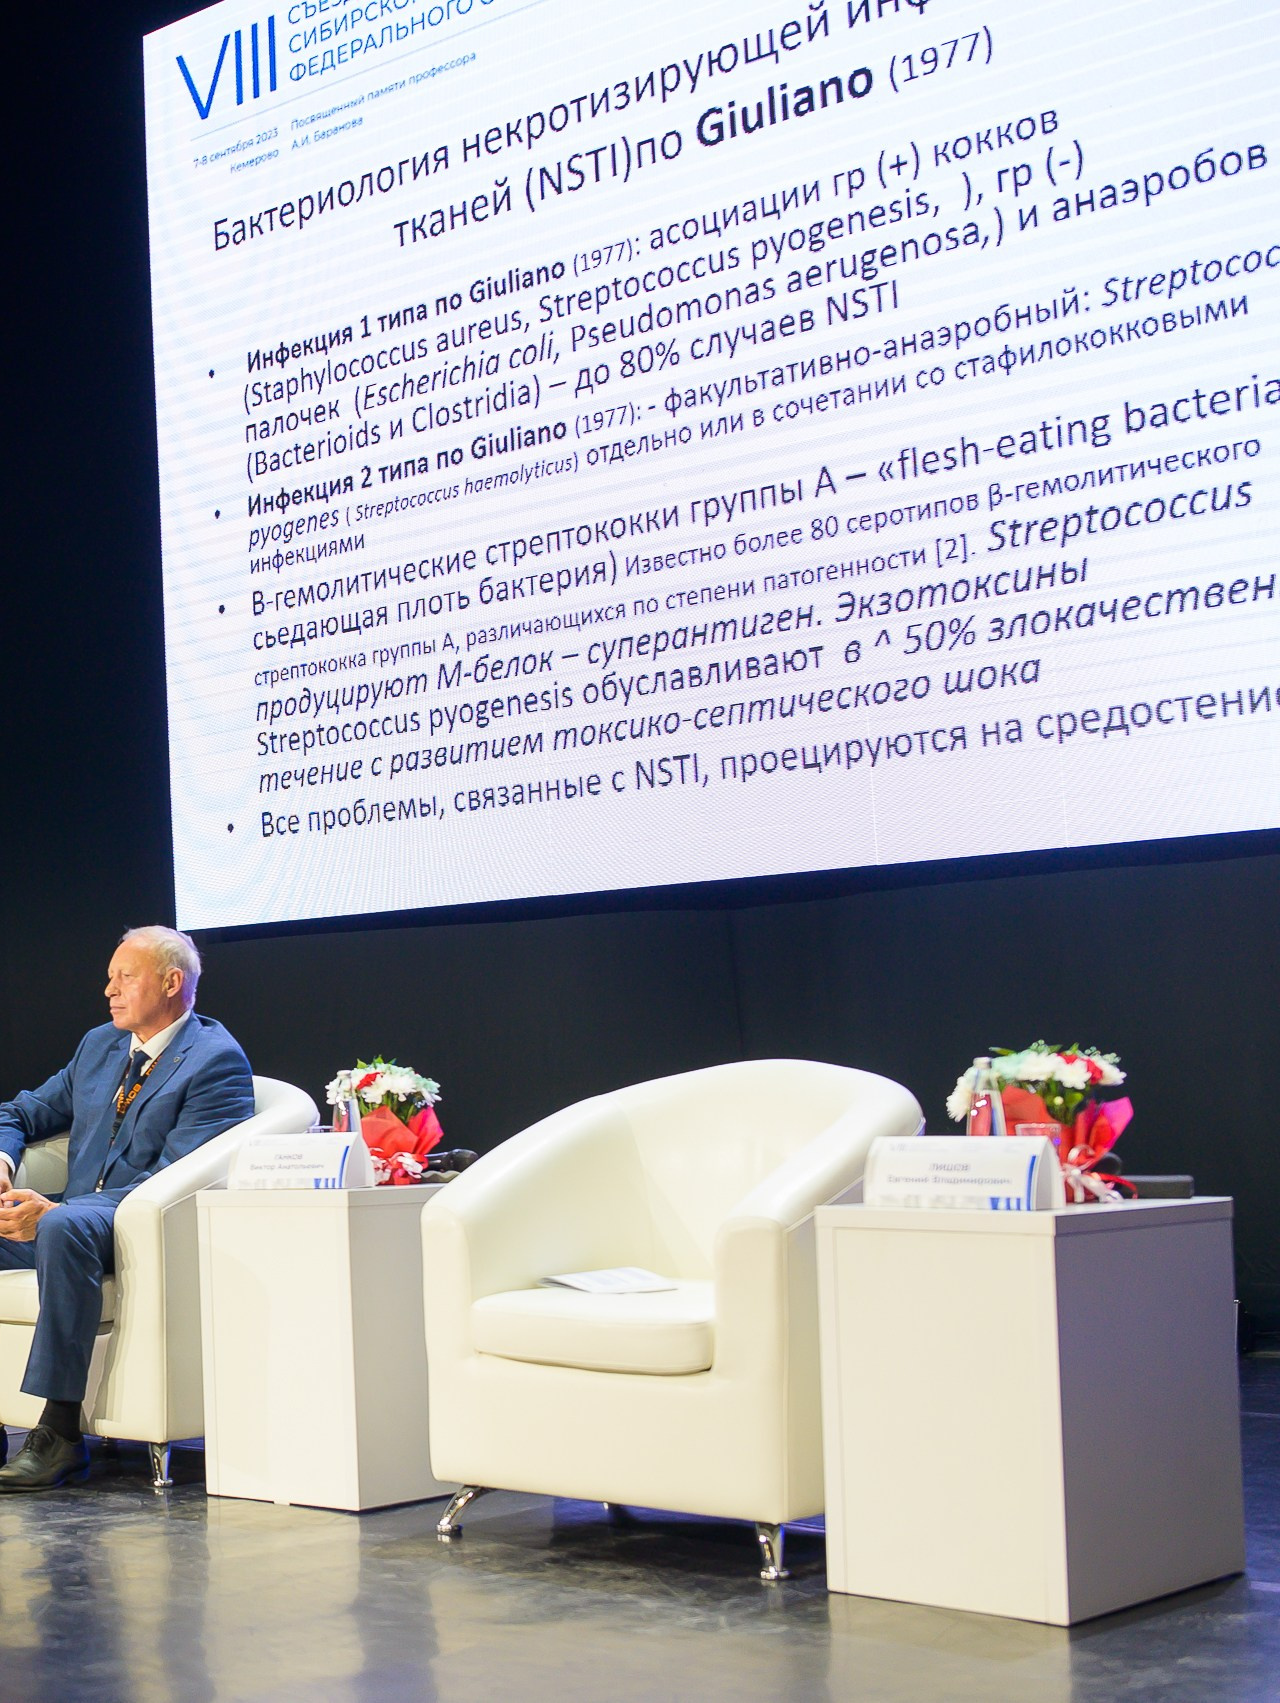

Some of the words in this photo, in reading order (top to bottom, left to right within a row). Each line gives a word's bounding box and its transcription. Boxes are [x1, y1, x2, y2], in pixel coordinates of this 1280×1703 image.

[176, 14, 277, 120] VIII
[213, 144, 449, 252] Бактериология
[462, 0, 830, 163] некротизирующей
[846, 0, 931, 29] ин
[289, 0, 474, 82] ФЕДЕРАЛЬНОГО
[393, 175, 512, 248] тканей
[695, 66, 874, 147] Giuliano
[889, 24, 993, 94] (1977)
[243, 337, 428, 416] (Staphylococcus
[436, 309, 530, 353] aureus,
[538, 246, 741, 336] Streptococcus
[751, 187, 940, 271] pyogenesis,
[996, 162, 1033, 198] гр
[1045, 138, 1085, 187] (-)
[245, 399, 340, 444] палочек
[354, 349, 501, 420] (Escherichia
[508, 332, 560, 369] coli,
[570, 277, 777, 353] Pseudomonas
[1052, 143, 1268, 222] анаэробов
[247, 324, 353, 374] Инфекция
[359, 314, 372, 339] 1
[376, 303, 428, 333] типа
[468, 260, 566, 304] Giuliano
[573, 237, 641, 278] (1977):
[649, 179, 821, 251] асоциации
[833, 167, 866, 199] гр
[877, 140, 921, 190] (+)
[933, 109, 1060, 168] кокков
[246, 420, 382, 484] (Bacterioids
[411, 373, 541, 433] Clostridia)
[574, 362, 611, 399] до
[619, 337, 681, 379] 80%
[690, 308, 816, 361] случаев
[826, 279, 899, 326] NSTI
[247, 475, 354, 518] Инфекция
[360, 464, 373, 489] 2
[377, 455, 429, 484] типа
[470, 421, 568, 460] Giuliano
[575, 401, 641, 440] (1977):
[664, 285, 1091, 418] факультативно-анаэробный:
[248, 509, 340, 553] pyogenes
[355, 484, 460, 522] Streptococcus
[464, 451, 579, 496] haemolyticus)
[586, 425, 692, 467] отдельно
[700, 412, 744, 441] или
[772, 374, 907, 423] сочетании
[954, 294, 1249, 381] стафилококковыми
[485, 505, 680, 567] стрептококки
[690, 478, 804, 528] группы
[877, 413, 1112, 482] «flesh-eating
[1123, 373, 1280, 435] bacteria
[250, 533, 365, 575] инфекциями
[254, 651, 367, 689] стрептококка
[372, 639, 436, 669] группы
[466, 602, 626, 653] различающихся
[665, 579, 756, 610] степени
[763, 547, 927, 592] патогенности
[935, 532, 976, 569] [2].
[986, 480, 1253, 553] Streptococcus
[256, 672, 428, 726] продуцируют
[437, 650, 554, 691] М-белок
[587, 604, 823, 671] суперантиген.
[834, 557, 1089, 623] Экзотоксины
[397, 590, 471, 623] плоть
[478, 549, 618, 605] бактерия)
[625, 543, 728, 578] Известно
[733, 527, 804, 556] более
[810, 515, 839, 541] 80
[846, 493, 980, 534] серотипов
[256, 711, 421, 757] Streptococcus
[429, 680, 574, 737] pyogenesis
[582, 645, 825, 707] обуславливают
[903, 614, 977, 656] 50%
[259, 759, 364, 794] течение
[389, 731, 544, 780] развитием
[552, 675, 932, 751] токсико-септического
[942, 658, 1042, 696] шока
[261, 810, 301, 838] Все
[308, 794, 446, 836] проблемы,
[453, 773, 602, 813] связанные
[635, 752, 709, 791] NSTI,
[720, 724, 968, 783] проецируются
[980, 717, 1024, 748] на
[1035, 685, 1280, 745] средостени
